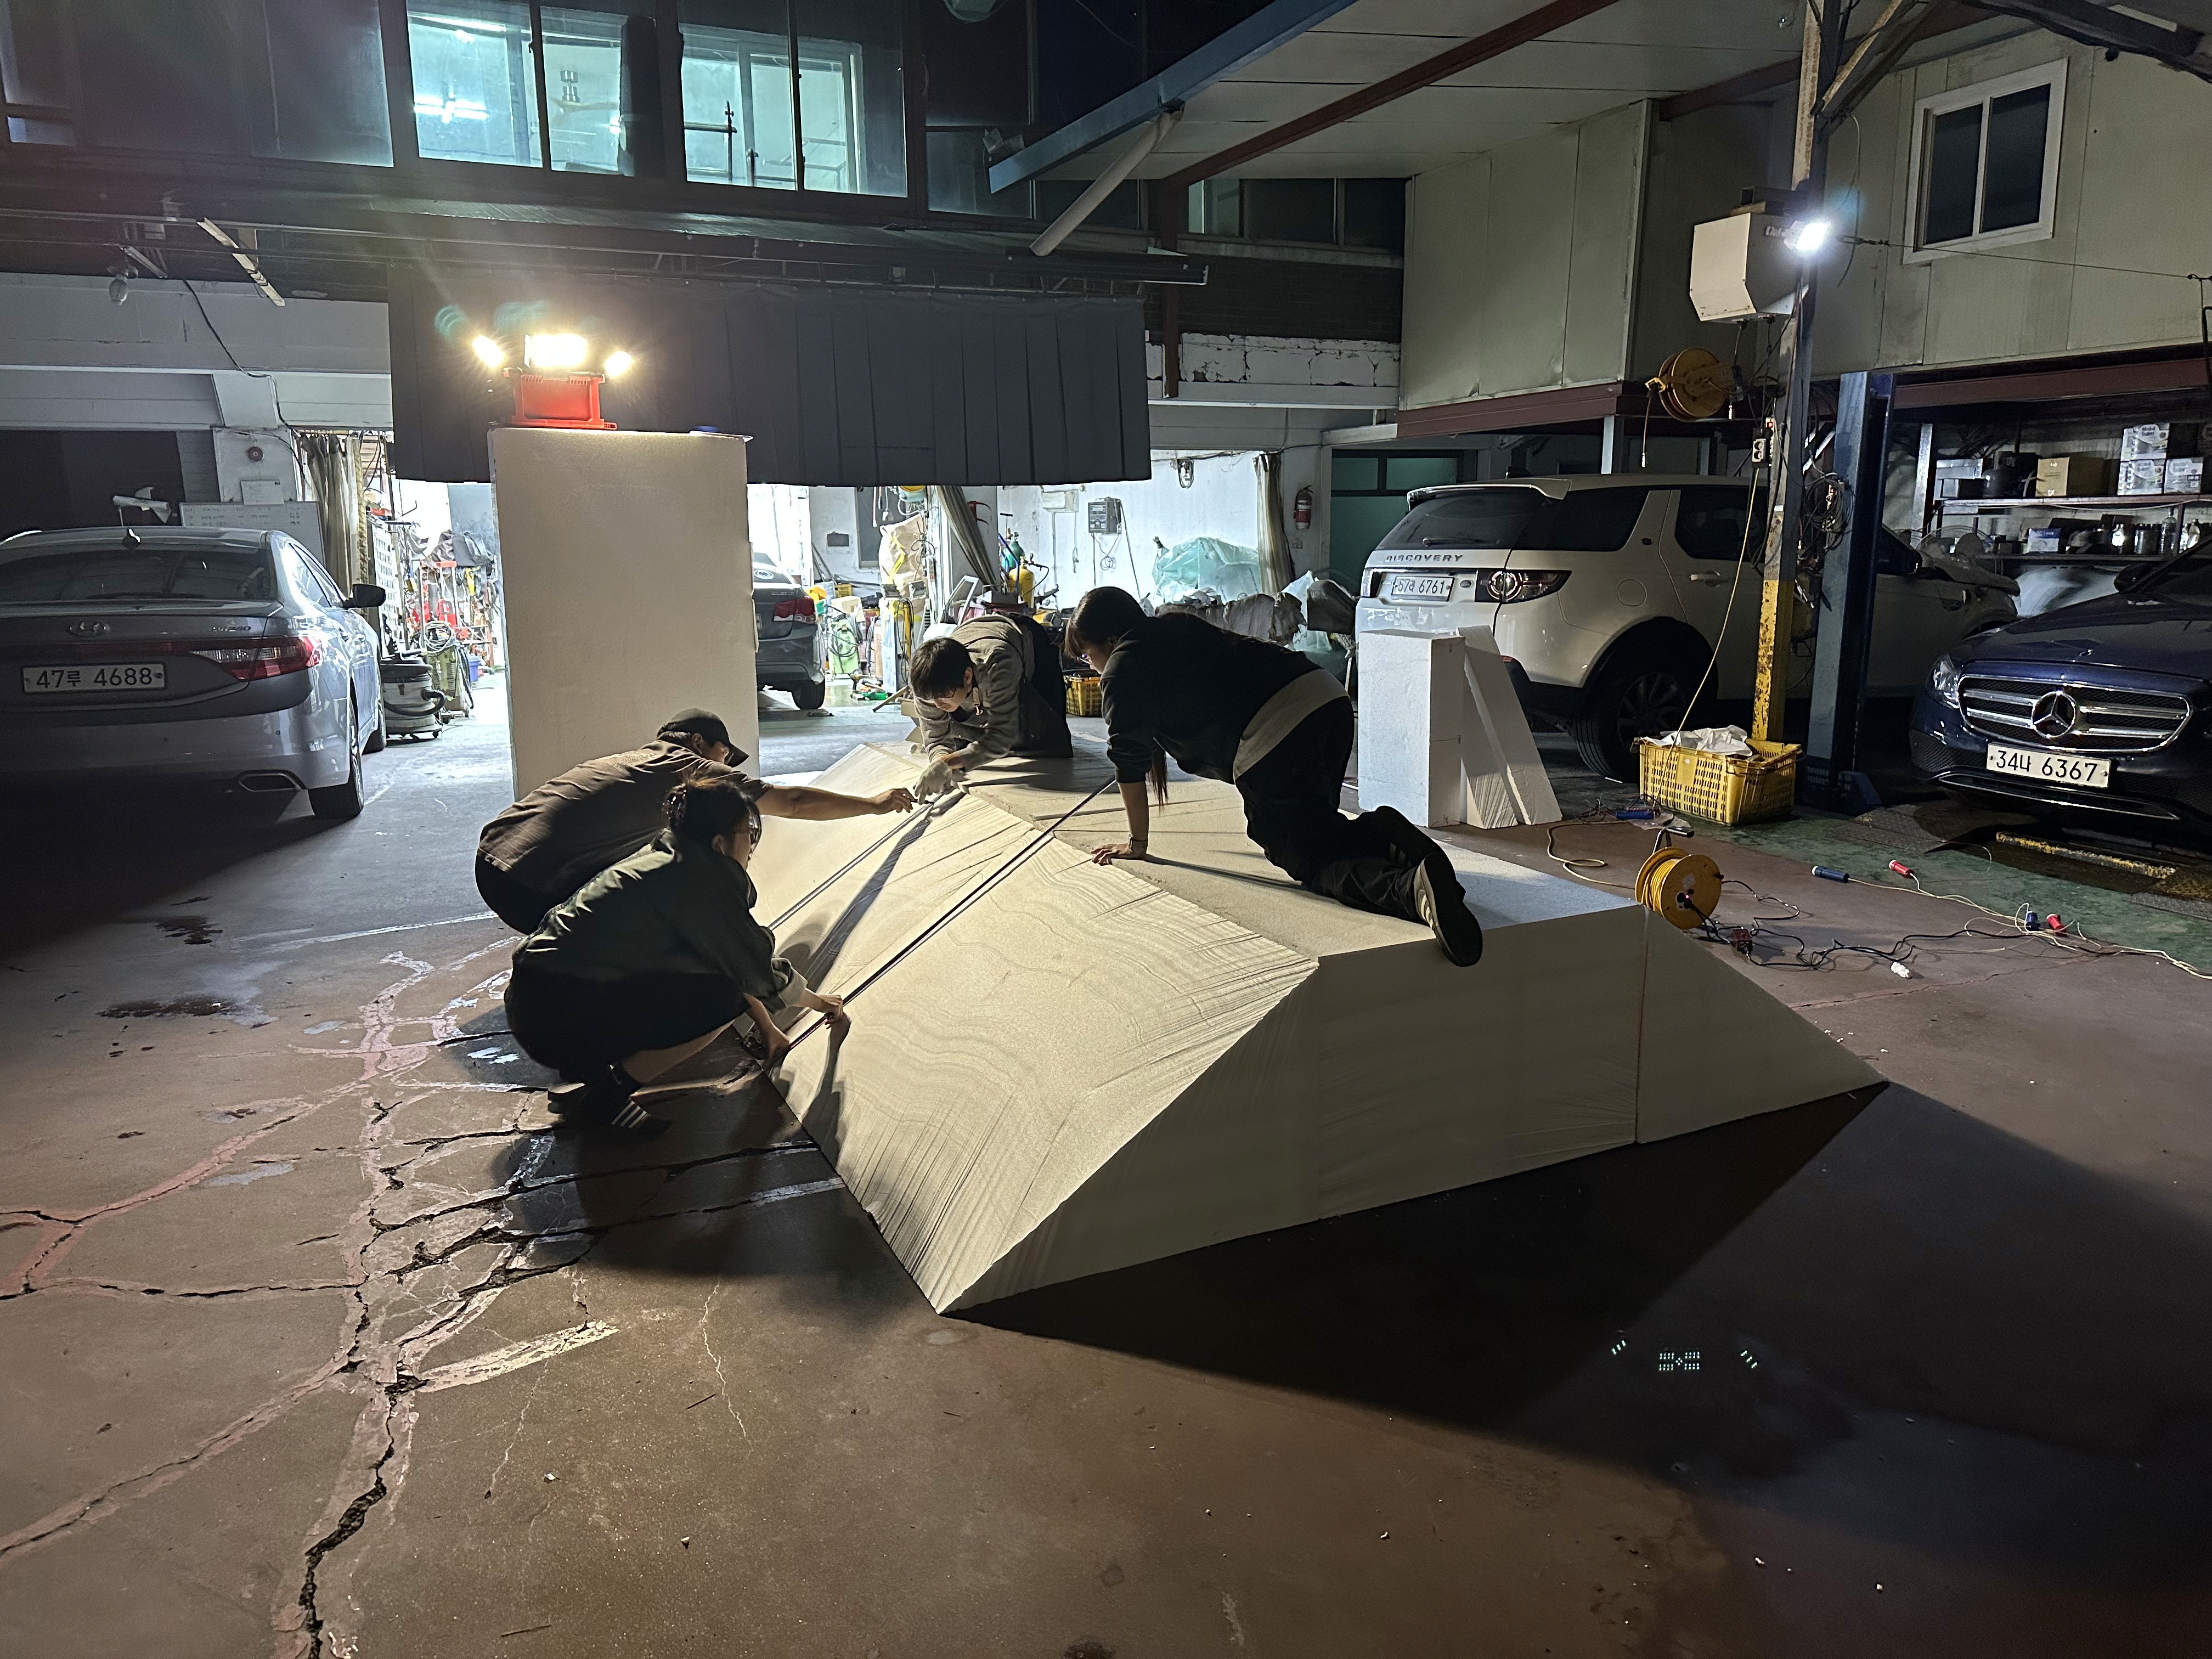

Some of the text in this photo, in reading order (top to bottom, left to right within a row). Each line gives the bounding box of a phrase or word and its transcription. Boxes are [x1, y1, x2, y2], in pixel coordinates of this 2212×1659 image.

[1419, 579, 1445, 594] 6761
[36, 667, 153, 689] 47루 4688
[1996, 749, 2098, 782] 34나 6367
